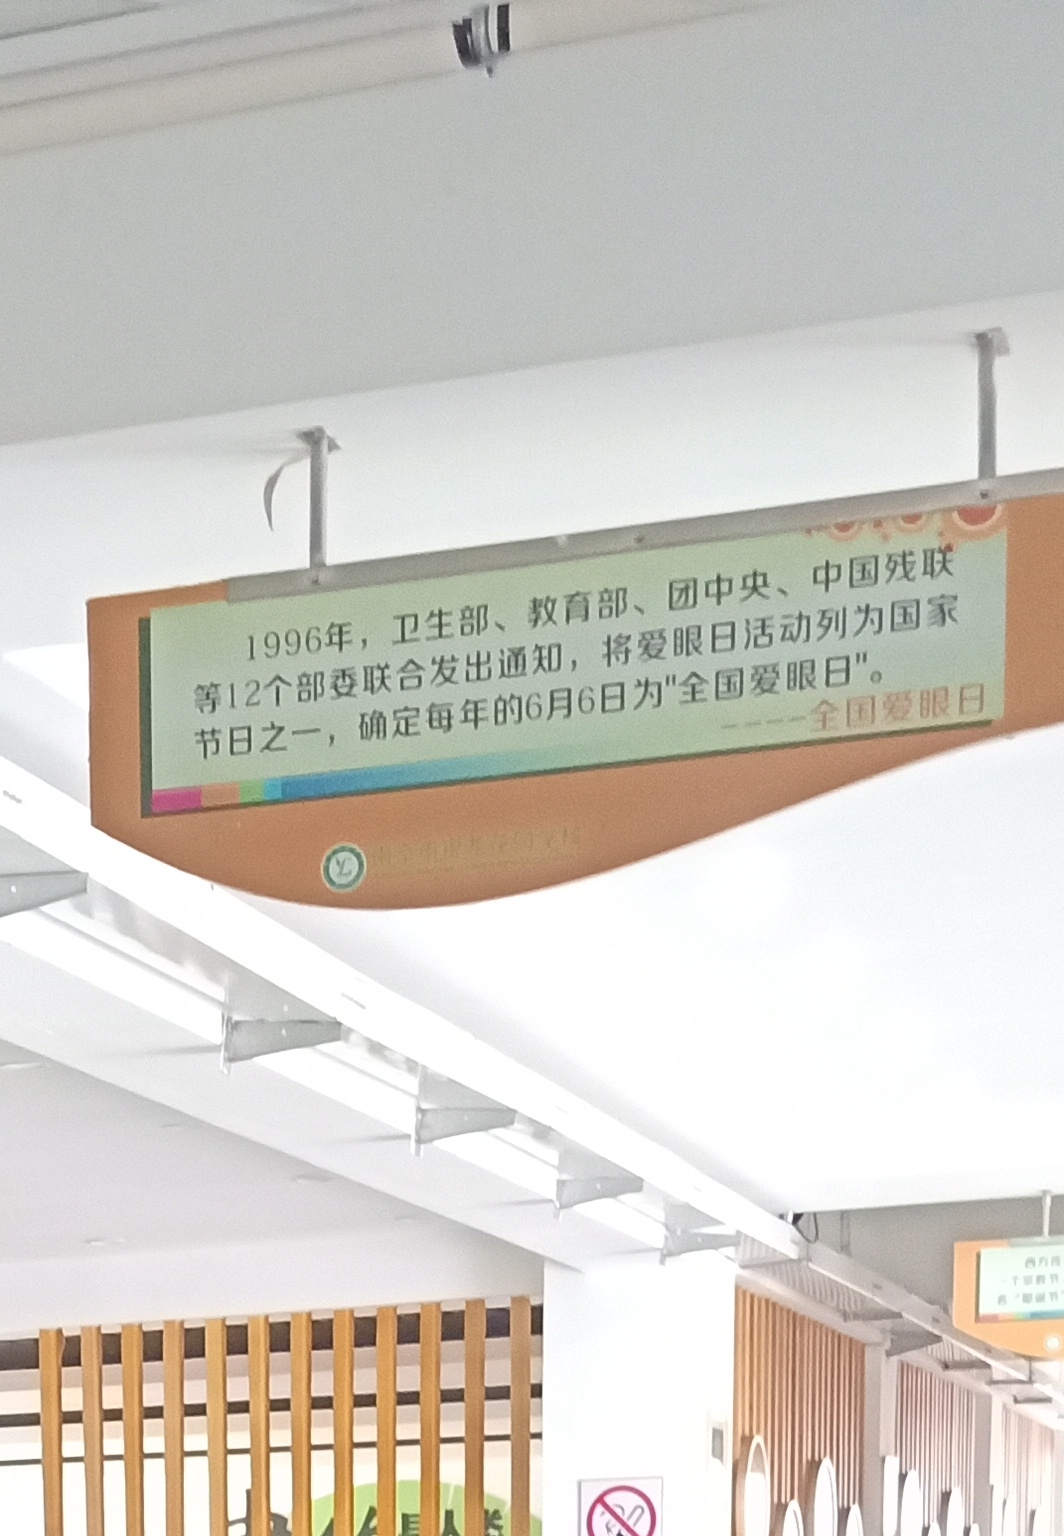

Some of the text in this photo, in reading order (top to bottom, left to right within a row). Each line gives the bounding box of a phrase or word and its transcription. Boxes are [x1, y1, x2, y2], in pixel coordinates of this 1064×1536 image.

[193, 594, 959, 714] 等12个部委联合发出通知，将爱眼日活动列为国家
[247, 546, 954, 661] 1996年，卫生部、教育部、团中央、中国残联
